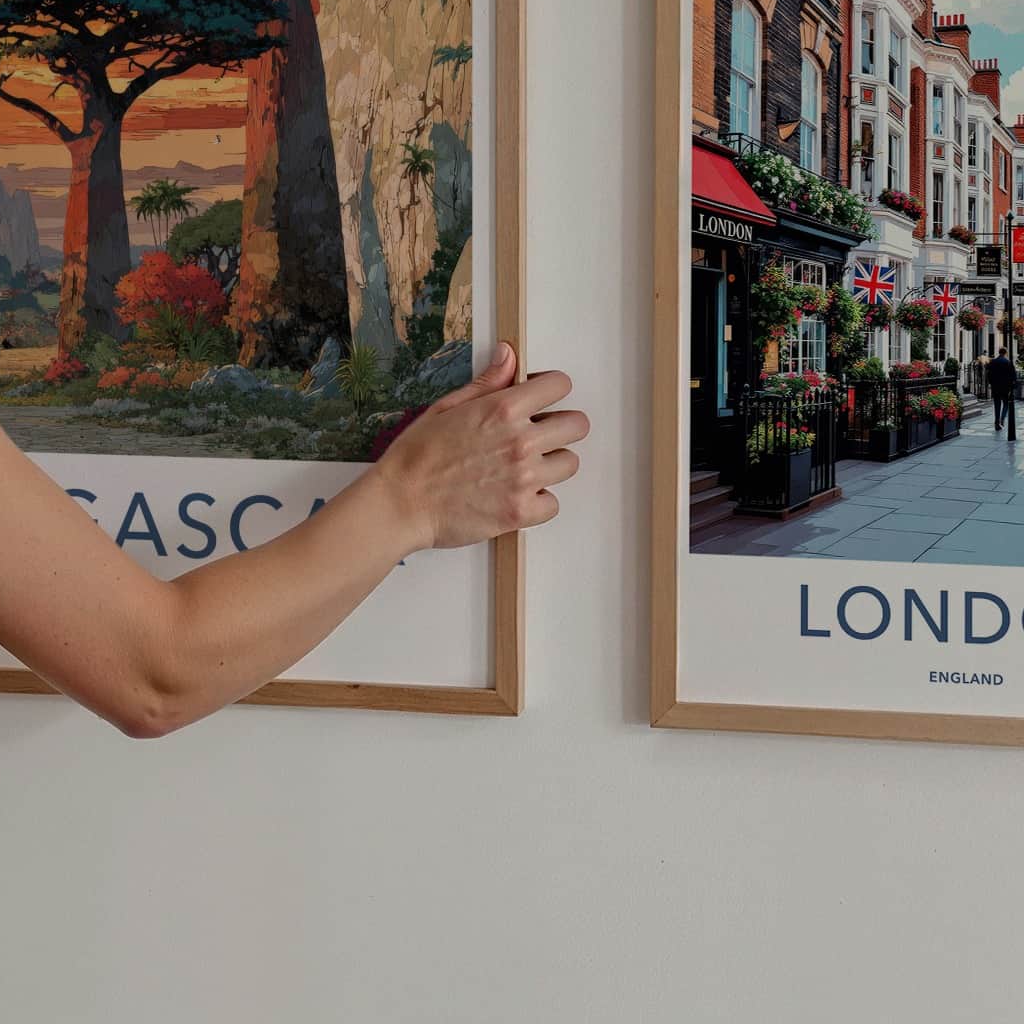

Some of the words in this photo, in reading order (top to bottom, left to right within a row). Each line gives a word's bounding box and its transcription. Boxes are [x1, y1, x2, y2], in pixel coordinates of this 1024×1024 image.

[698, 213, 753, 242] LONDON
[800, 584, 1024, 644] LOND
[929, 671, 1004, 686] ENGLAND
